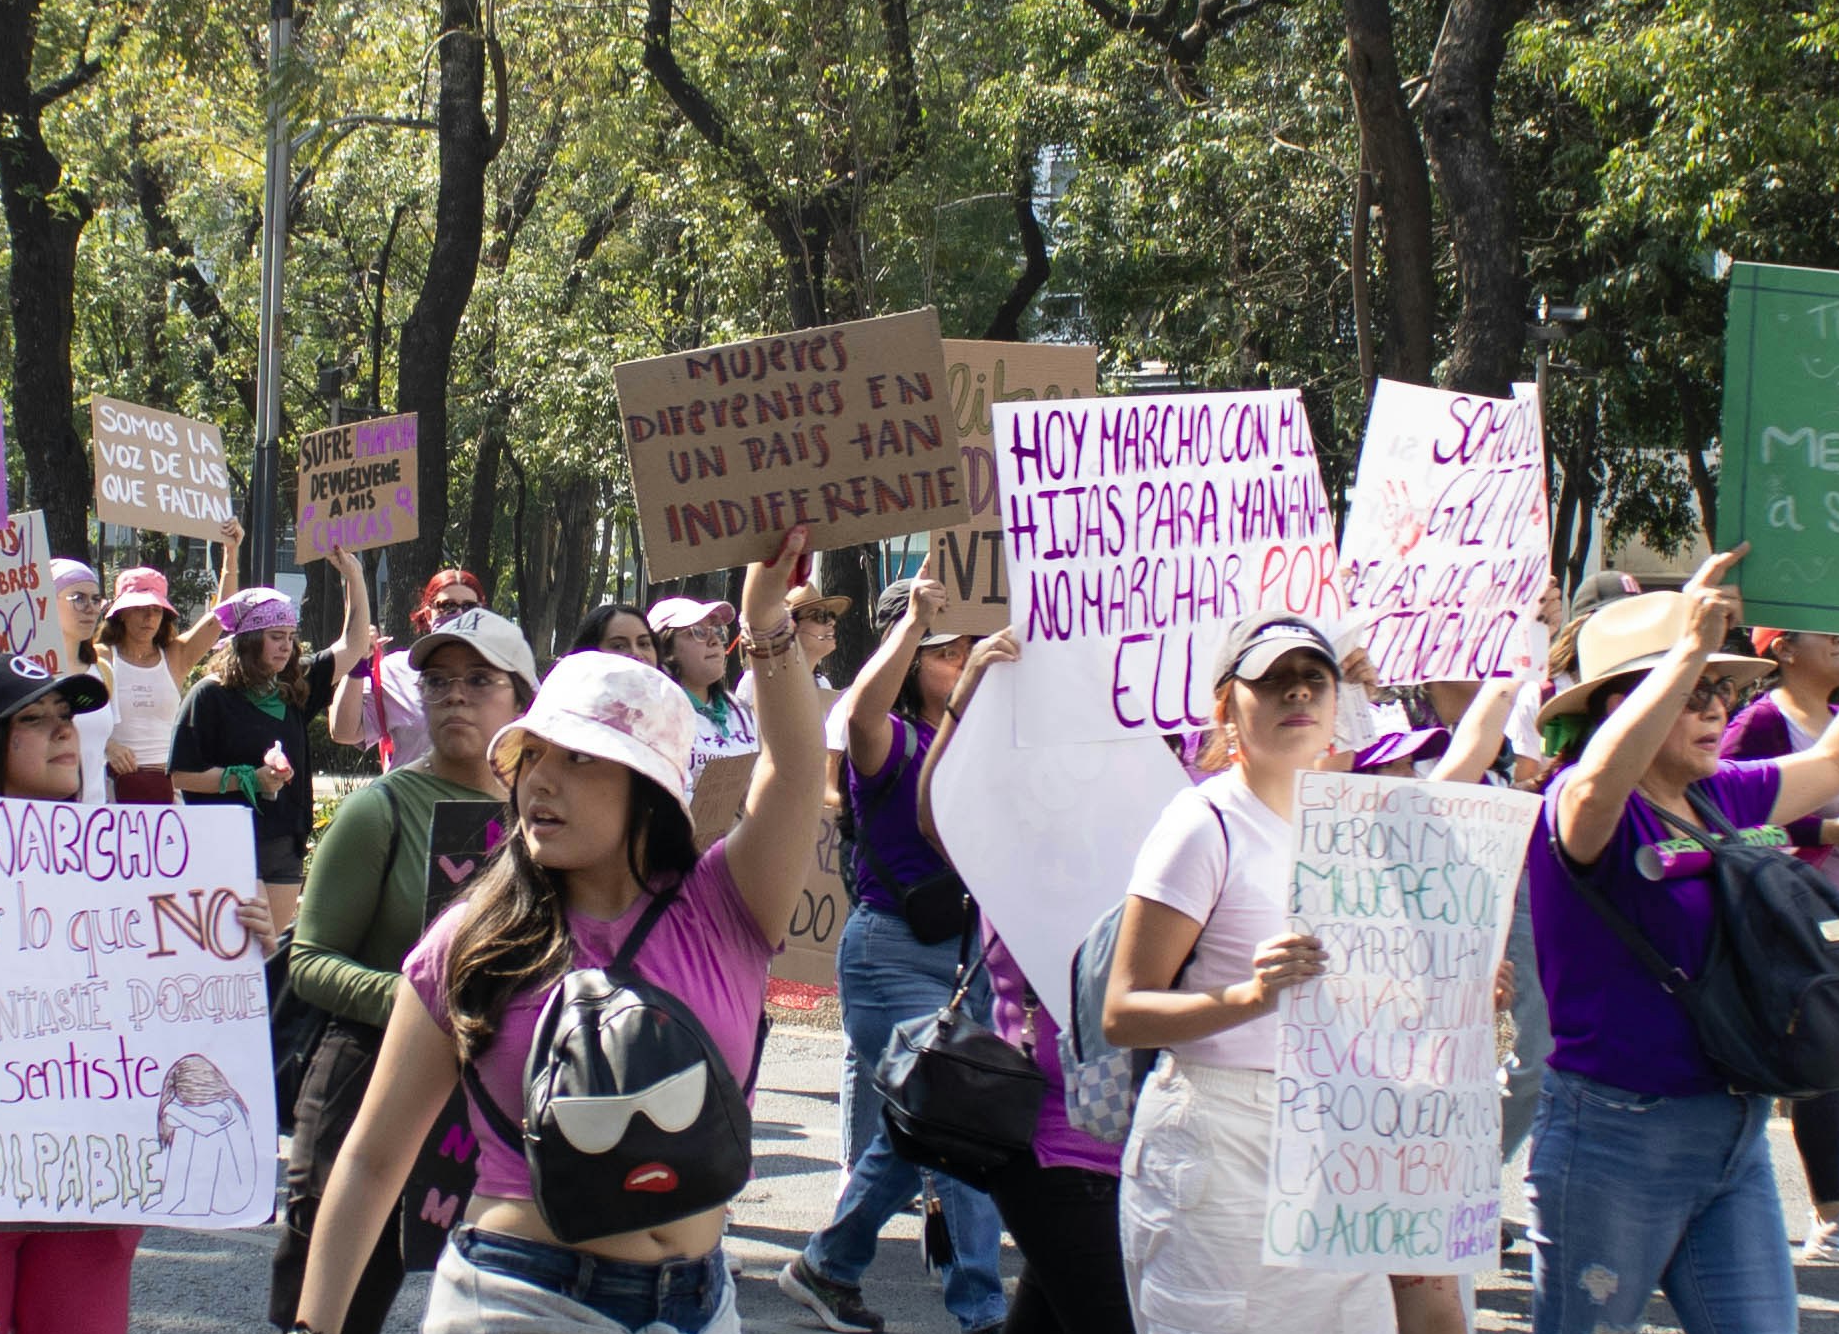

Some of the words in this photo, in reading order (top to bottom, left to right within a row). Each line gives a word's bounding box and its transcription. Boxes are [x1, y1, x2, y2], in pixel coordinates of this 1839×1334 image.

[867, 371, 935, 410] EN
[99, 404, 179, 447] SOMOS
[186, 427, 219, 456] LA
[301, 427, 354, 474] SUFRE
[1009, 407, 1088, 486] HOY
[1100, 402, 1213, 478] MARCHO
[1220, 402, 1270, 463] CON
[98, 439, 146, 471] VOZ
[150, 448, 184, 479] DE
[188, 457, 229, 489] LAS
[668, 445, 729, 485] UN
[101, 472, 148, 508] QUE
[156, 483, 234, 524] FALTAN
[329, 497, 343, 518] A
[346, 489, 376, 513] MIS
[664, 465, 961, 548] INDIFERENTE
[1007, 484, 1126, 562] HIJAS
[1135, 480, 1220, 551] PARA
[1229, 463, 1334, 545] MAÑANA
[1427, 462, 1542, 550] GRITO
[1767, 494, 1806, 532] a
[312, 506, 394, 554] CHICAS
[35, 596, 48, 620] Y
[1027, 569, 1073, 643] NO
[1080, 553, 1243, 636] MARCHAR
[1257, 541, 1343, 619] POR
[1369, 563, 1426, 609] LAS
[1112, 631, 1211, 730] ELL
[1299, 806, 1412, 862] FUERON
[16, 879, 53, 952] lo
[66, 906, 148, 979] que
[146, 887, 252, 961] NO
[126, 972, 269, 1033] PORQUE
[0, 1034, 161, 1105] sentiste
[1275, 1076, 1366, 1133] PERO
[1275, 1137, 1334, 1195] LA
[1268, 1199, 1443, 1259] CO-AUTORES
